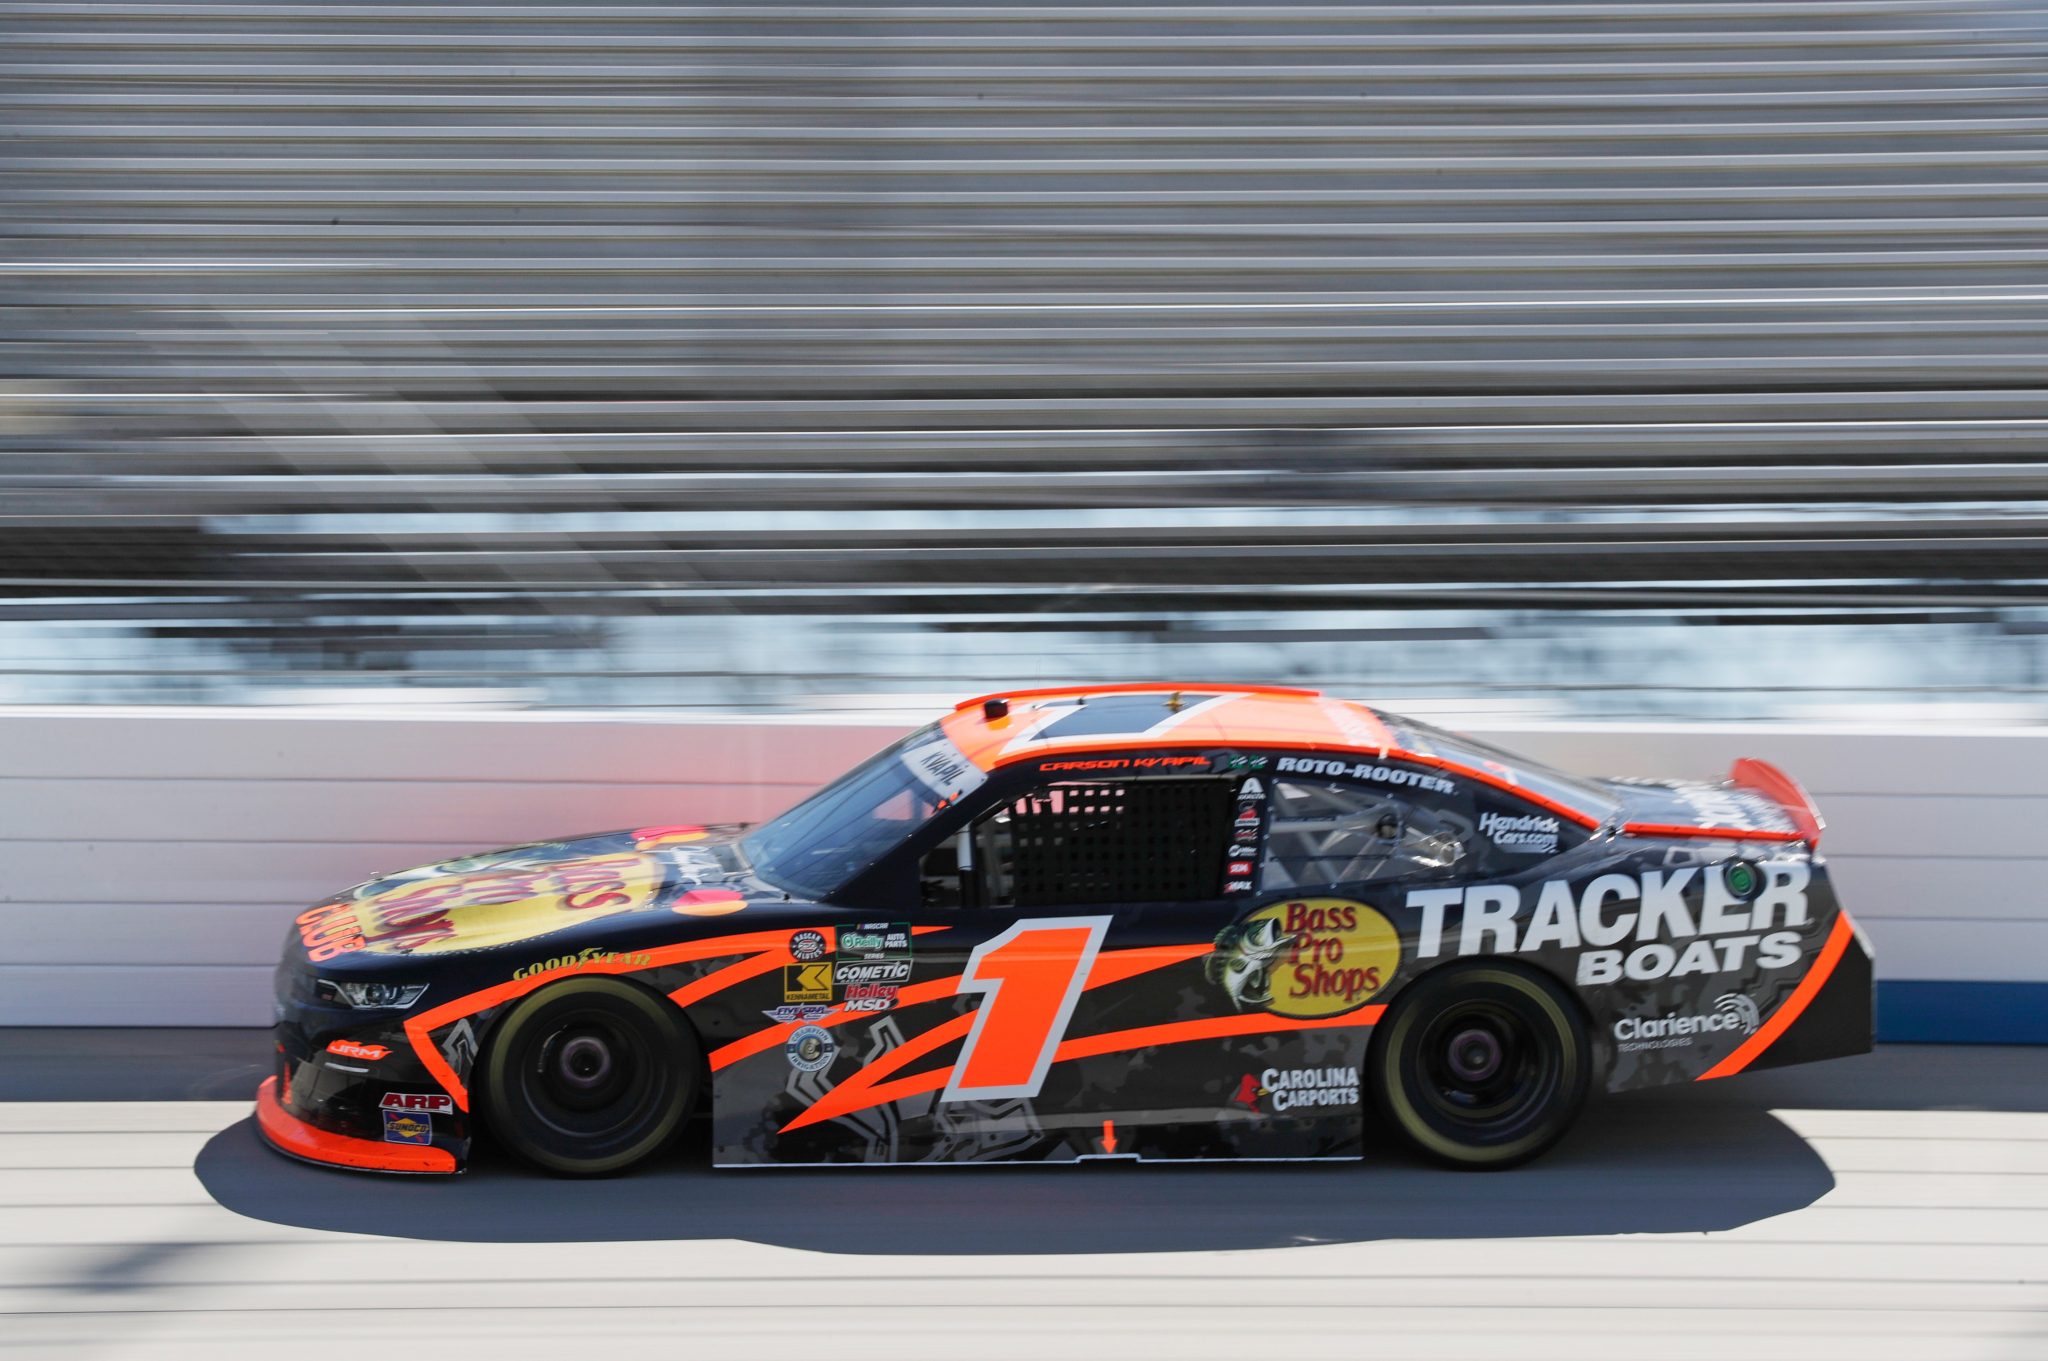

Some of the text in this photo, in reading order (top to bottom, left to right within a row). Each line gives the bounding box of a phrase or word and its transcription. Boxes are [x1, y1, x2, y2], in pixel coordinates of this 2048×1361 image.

[919, 751, 965, 786] KVAPIL
[1039, 756, 1211, 772] CARSON KVAPIL
[1276, 757, 1456, 794] ROTO-ROOTER
[1284, 902, 1357, 932] Bass
[1405, 860, 1811, 958] TRACKER
[295, 903, 367, 962] CLUB
[884, 940, 908, 948] PARTS
[1287, 933, 1343, 964] Pro
[1576, 930, 1802, 986] BOATS
[513, 947, 651, 981] GOODYEAR
[836, 960, 910, 980] COMETIC
[845, 984, 898, 1001] Holley
[1289, 963, 1380, 1003] Shops
[844, 999, 890, 1012] MSD
[940, 914, 1114, 1103] 1
[1614, 1012, 1742, 1041] Clarience
[1616, 1037, 1694, 1053] TECHNOLOGIES
[1261, 1067, 1360, 1092] CAROLINA
[382, 1093, 452, 1109] ARP
[1272, 1086, 1359, 1111] CARPORTS
[389, 1121, 428, 1133] SUNOCO
